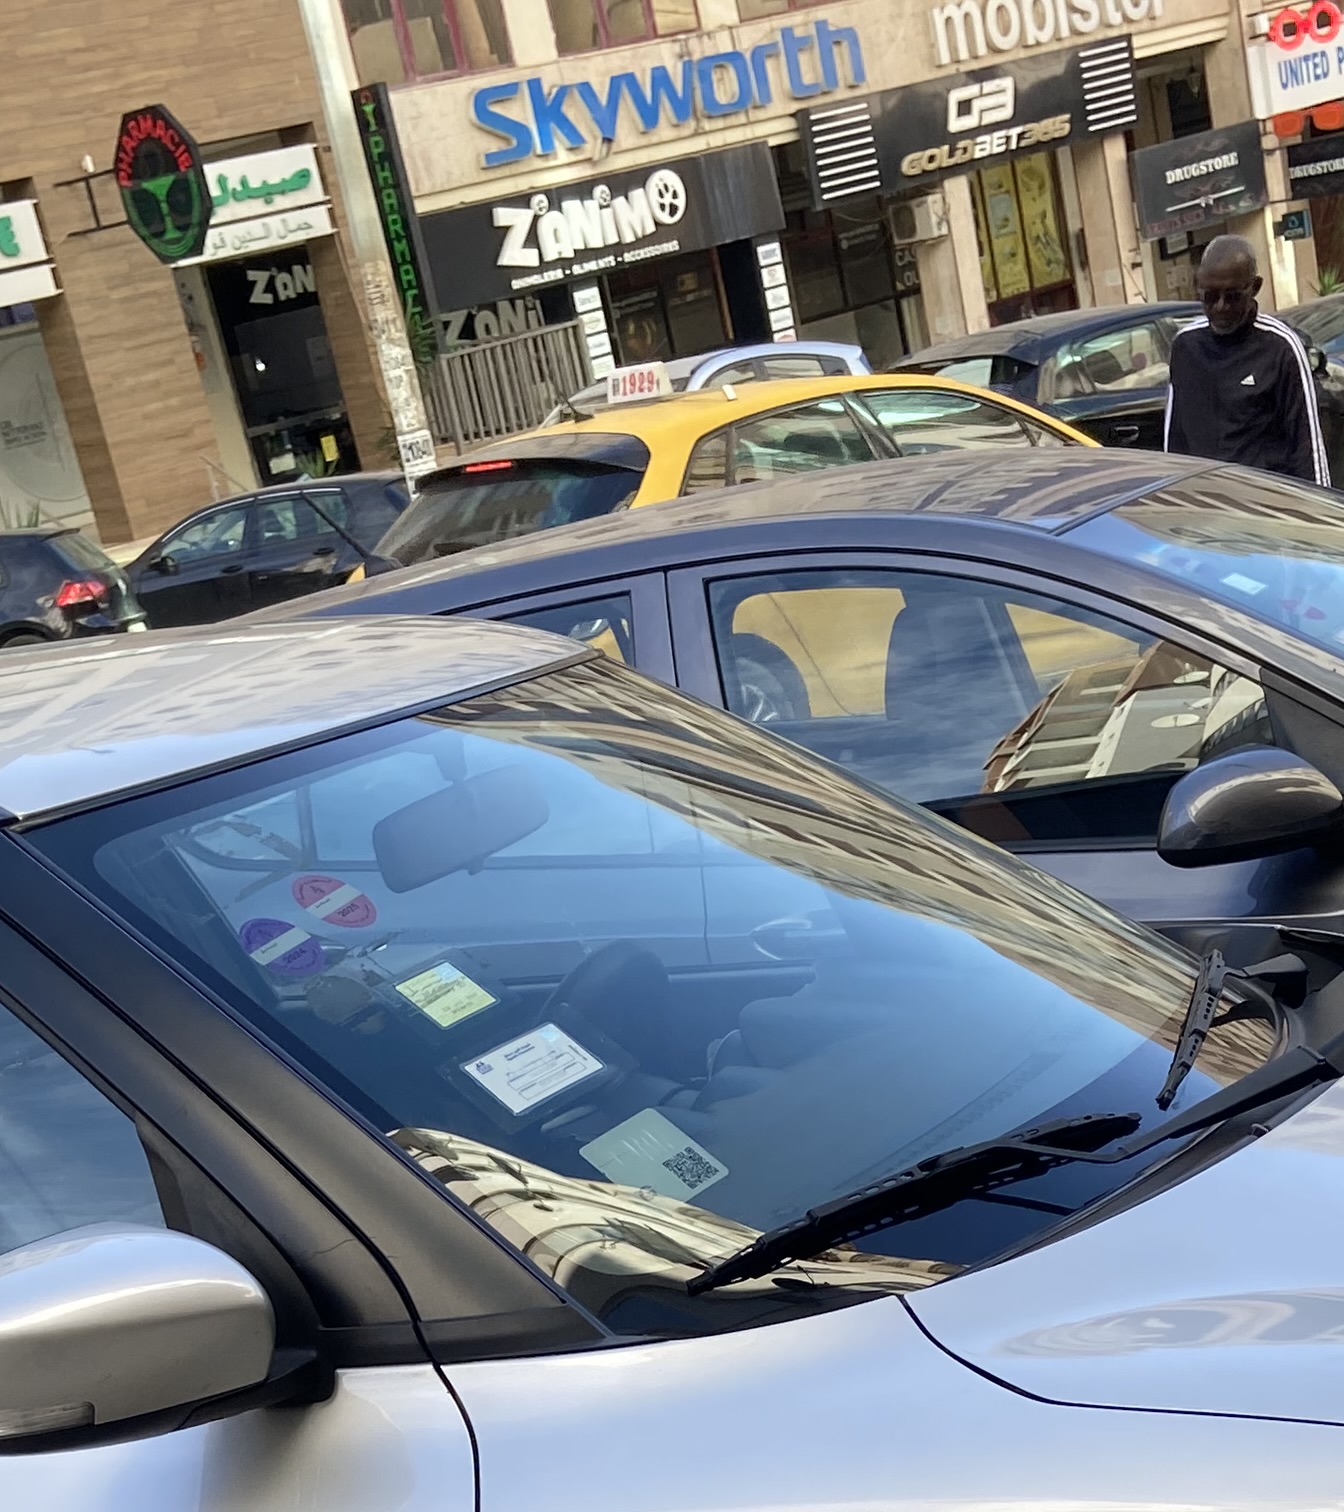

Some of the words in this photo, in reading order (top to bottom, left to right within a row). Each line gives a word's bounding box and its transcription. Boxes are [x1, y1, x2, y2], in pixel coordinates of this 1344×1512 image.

[929, 0, 1164, 66] mobis
[1277, 49, 1330, 91] UNITED
[117, 113, 193, 187] PHARMACIE
[900, 113, 1072, 177] GOLDBET365
[1165, 151, 1239, 185] DRUGSTORE
[210, 168, 311, 216] صيدل
[246, 263, 317, 305] ZAN
[621, 370, 655, 397] 1929
